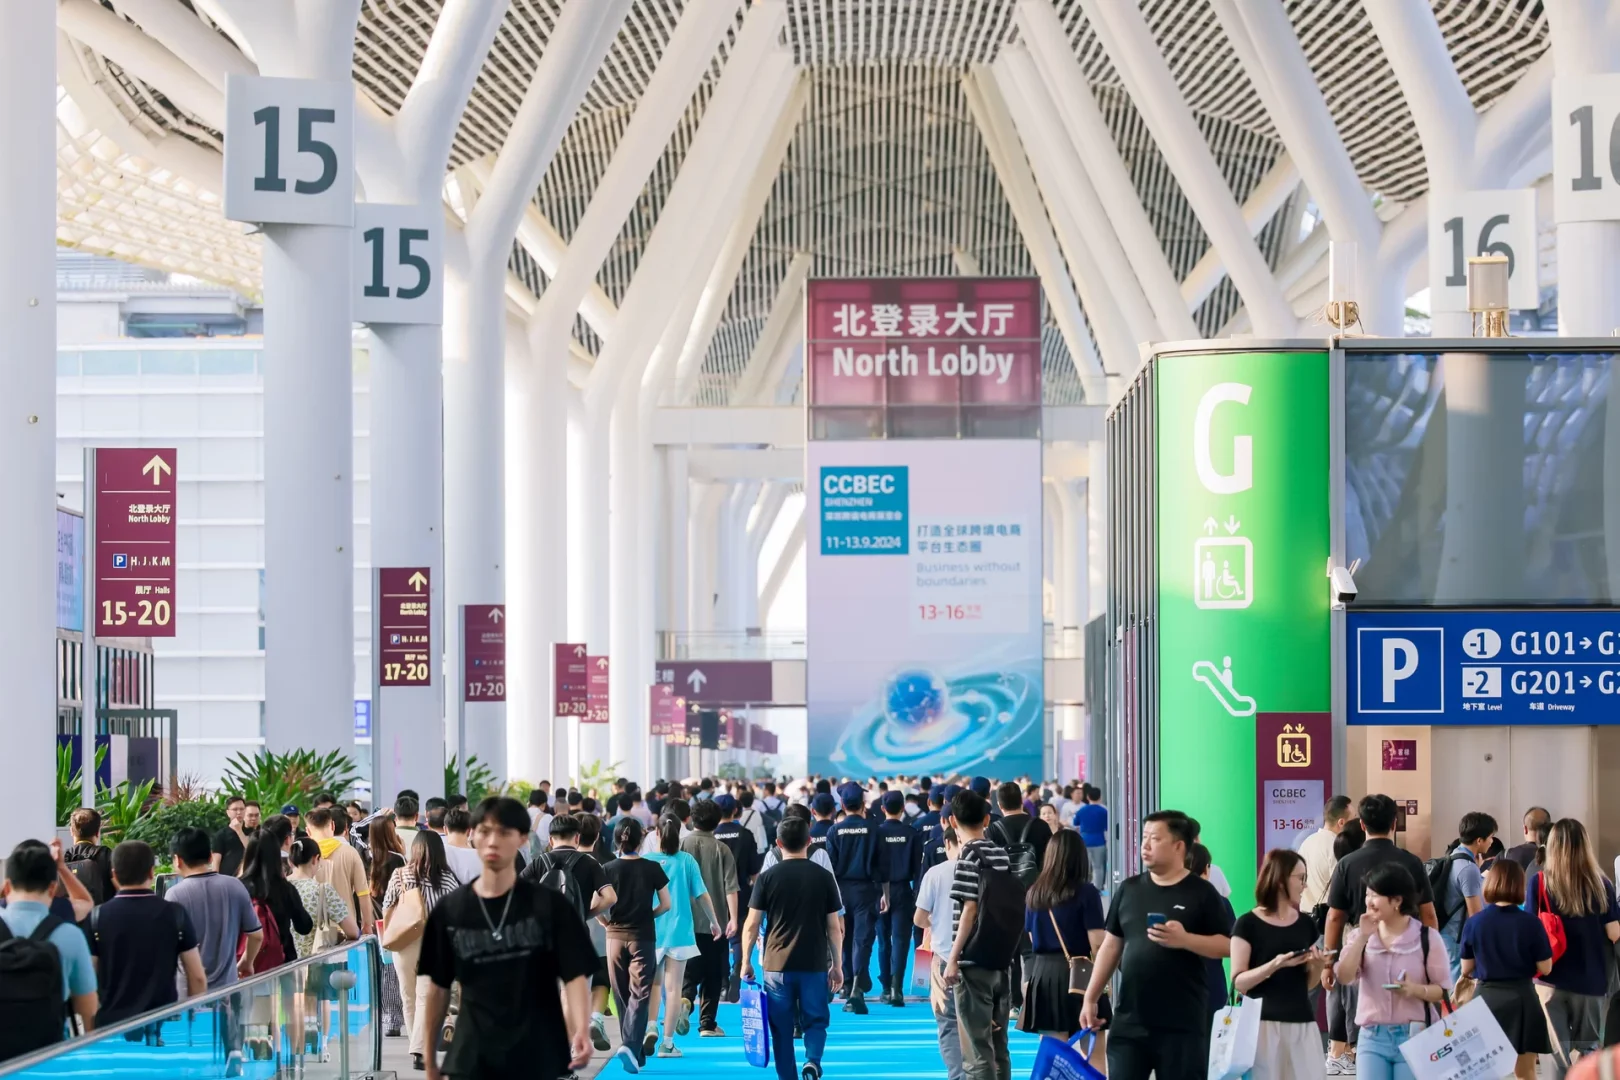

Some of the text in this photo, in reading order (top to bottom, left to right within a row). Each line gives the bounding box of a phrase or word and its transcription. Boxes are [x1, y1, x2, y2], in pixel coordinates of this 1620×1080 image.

[253, 106, 338, 194] 15
[1570, 105, 1620, 191] 1
[363, 228, 431, 299] 15
[833, 303, 1015, 337] 北登录大厅
[833, 345, 1014, 384] North Lobby
[1193, 382, 1253, 495] G
[823, 474, 895, 494] CCBEC
[128, 514, 171, 525] North Lobby
[826, 536, 902, 549] 11-13.9.2024
[916, 562, 1020, 573] Business without
[101, 599, 171, 626] 15-20
[918, 604, 965, 620] 13-16
[1469, 631, 1620, 656] -1 G101 G
[384, 663, 429, 681] 17-20
[1382, 637, 1419, 703] P
[468, 682, 504, 697] 17-20
[1467, 670, 1620, 695] -2 G201 G
[558, 702, 586, 714] 17-20
[583, 710, 608, 721] 7-20
[1487, 703, 1502, 711] Level
[1547, 703, 1575, 713] Driveway
[1272, 788, 1307, 798] CCBEC
[1273, 819, 1304, 830] 13-16
